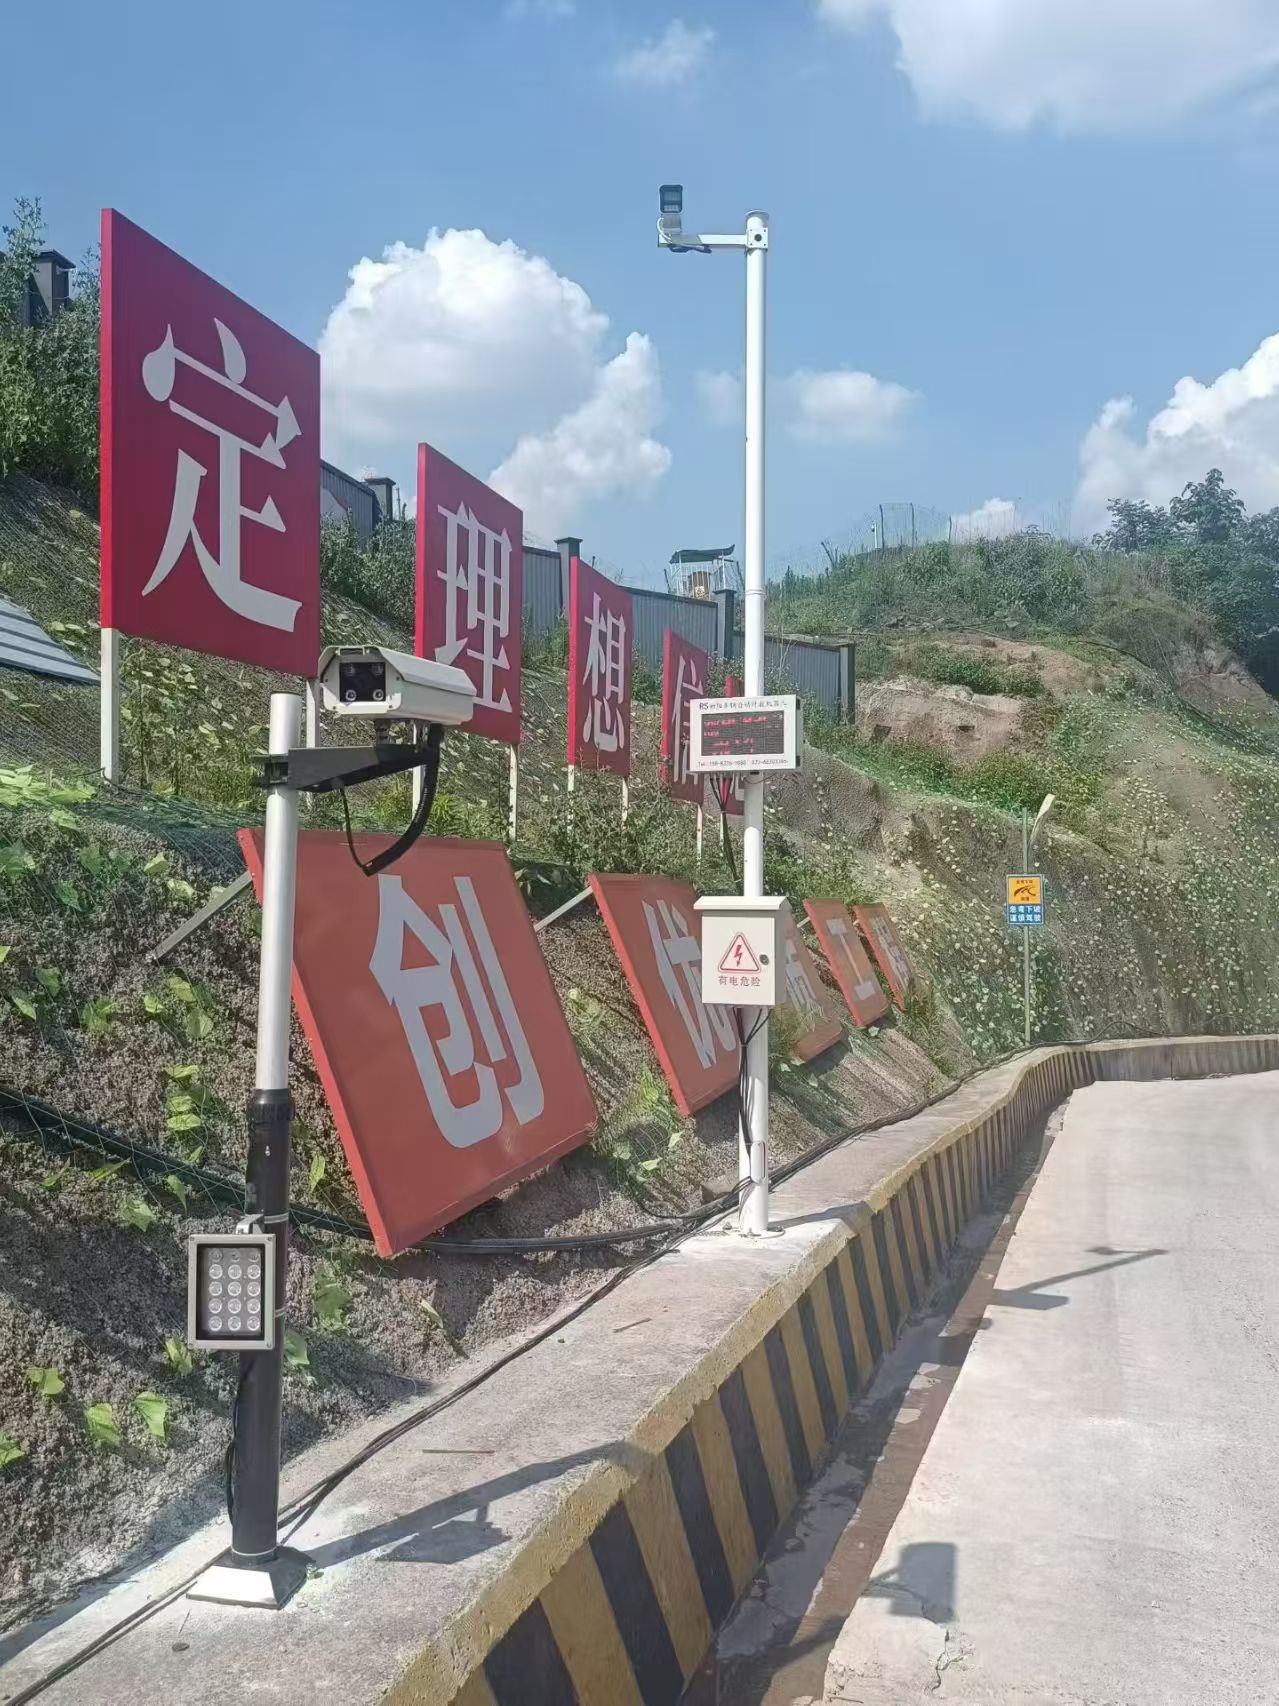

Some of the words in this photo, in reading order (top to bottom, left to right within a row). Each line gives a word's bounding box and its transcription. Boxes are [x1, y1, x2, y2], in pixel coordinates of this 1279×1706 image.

[141, 317, 302, 632] 定
[435, 500, 513, 712] 理
[582, 591, 627, 752] 想
[369, 874, 545, 1148] 创
[718, 975, 761, 987] 有电危险
[826, 918, 876, 1001] 工
